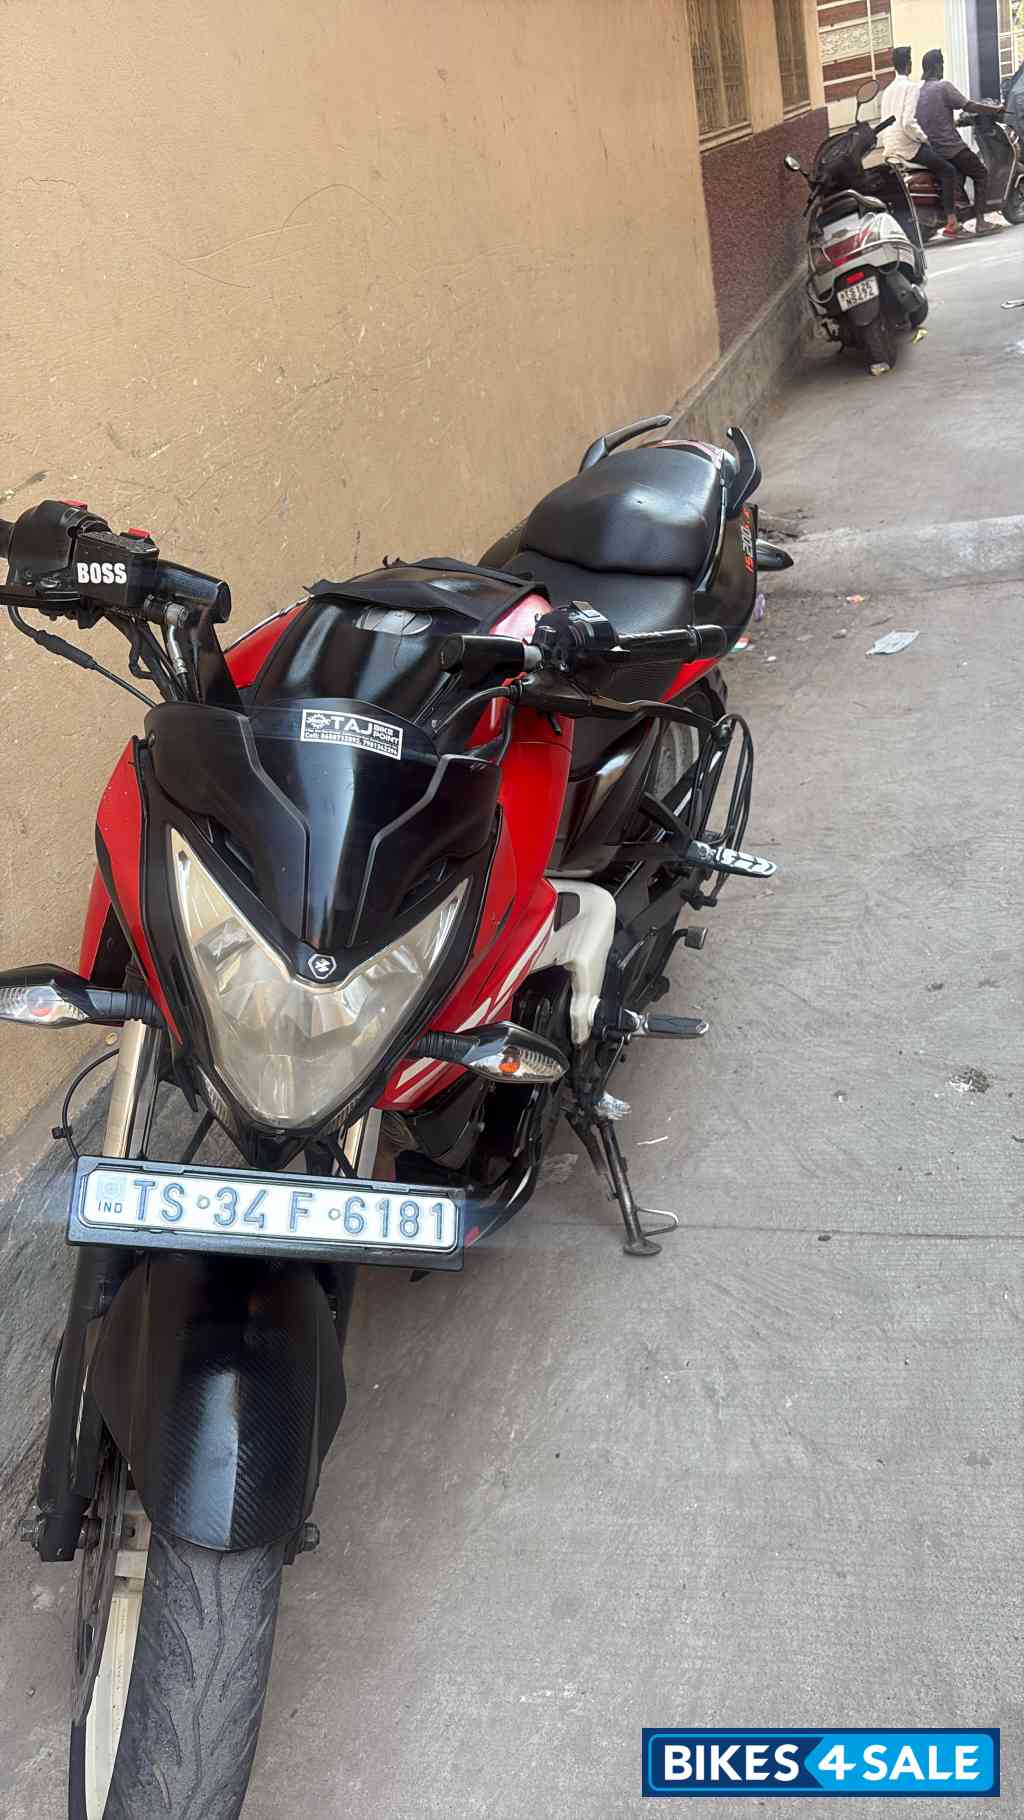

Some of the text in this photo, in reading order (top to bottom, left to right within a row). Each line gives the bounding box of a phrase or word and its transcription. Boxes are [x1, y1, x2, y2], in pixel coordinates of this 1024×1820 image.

[76, 562, 127, 584] BOSS
[330, 716, 373, 735] TAJ
[373, 731, 400, 745] POINT
[98, 1201, 123, 1214] IND
[133, 1179, 444, 1241] TS 34 F 6181
